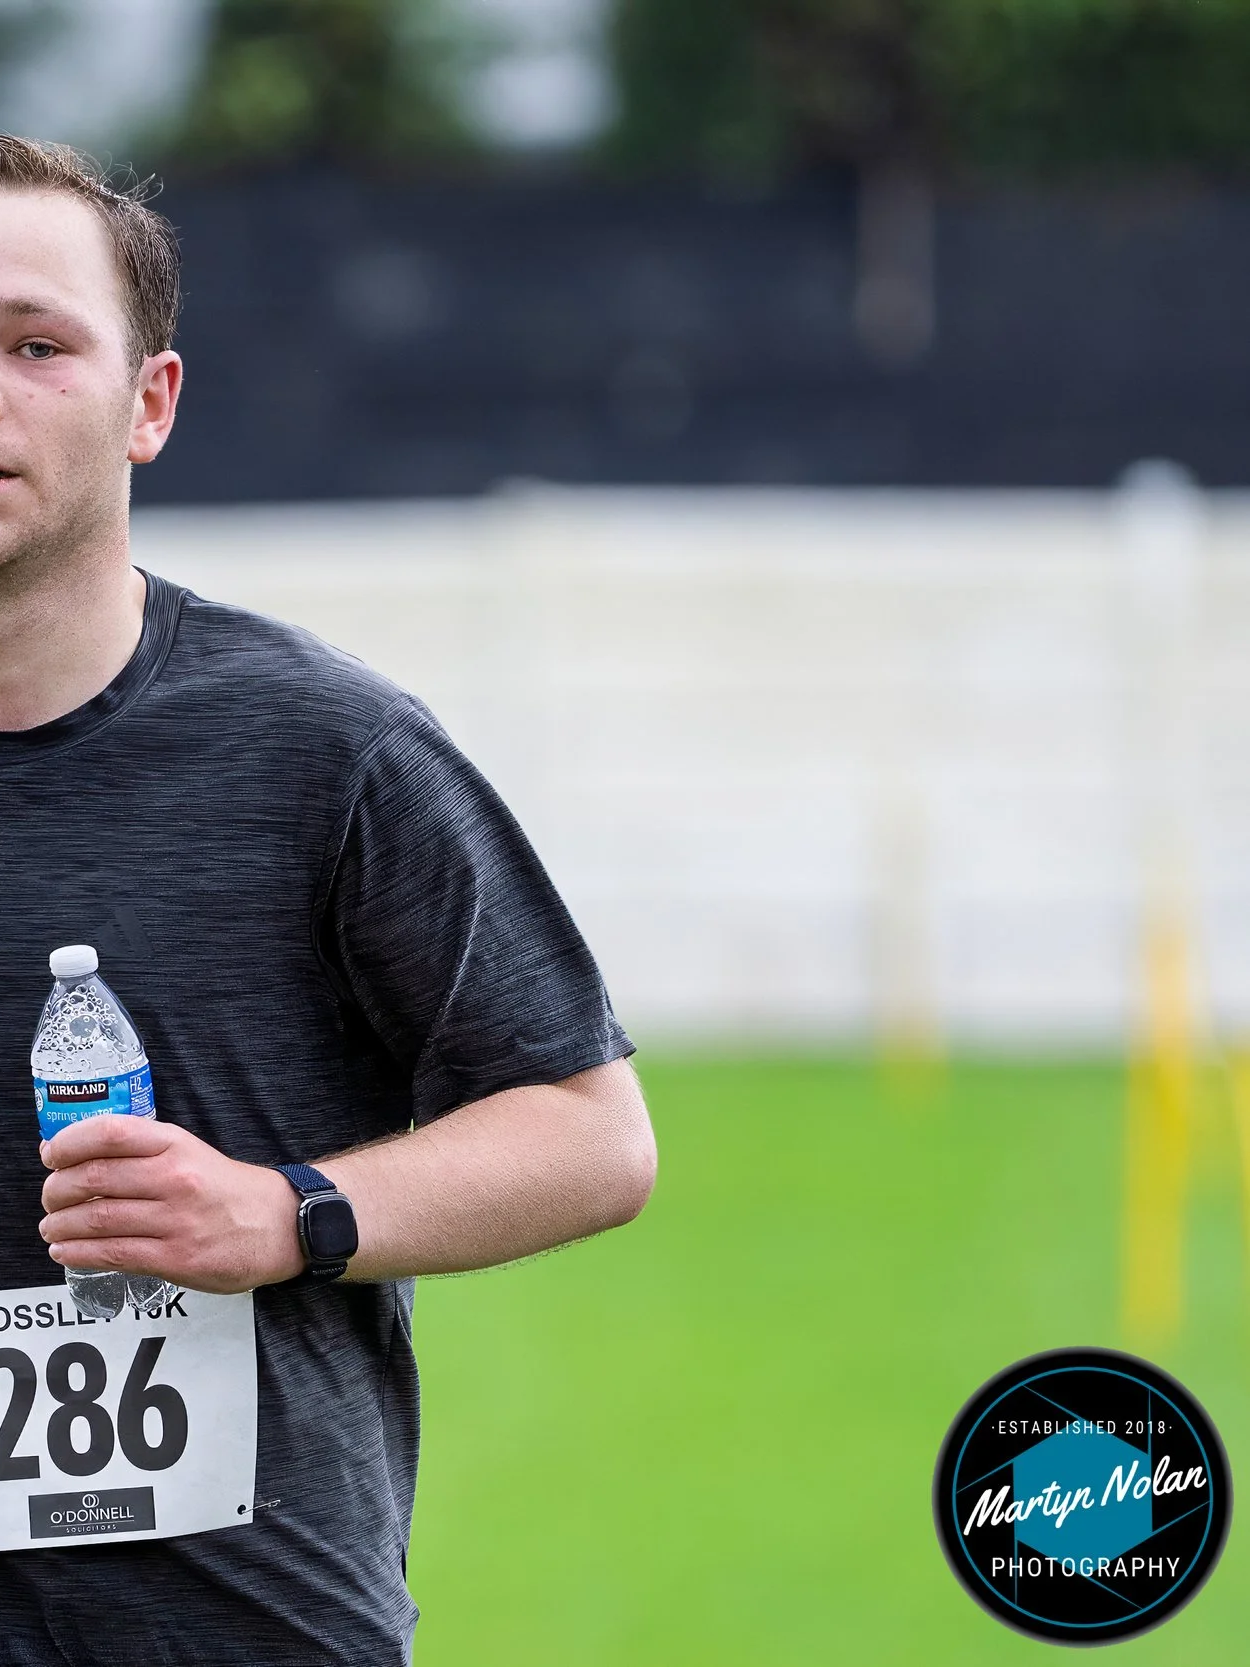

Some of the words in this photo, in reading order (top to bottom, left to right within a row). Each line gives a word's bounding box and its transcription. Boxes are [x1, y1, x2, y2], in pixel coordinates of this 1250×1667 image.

[49, 1083, 106, 1095] KIRKLAND
[47, 1111, 77, 1123] spring
[50, 1506, 134, 1524] O'DONNELL
[66, 1524, 117, 1533] SOLICITORS
